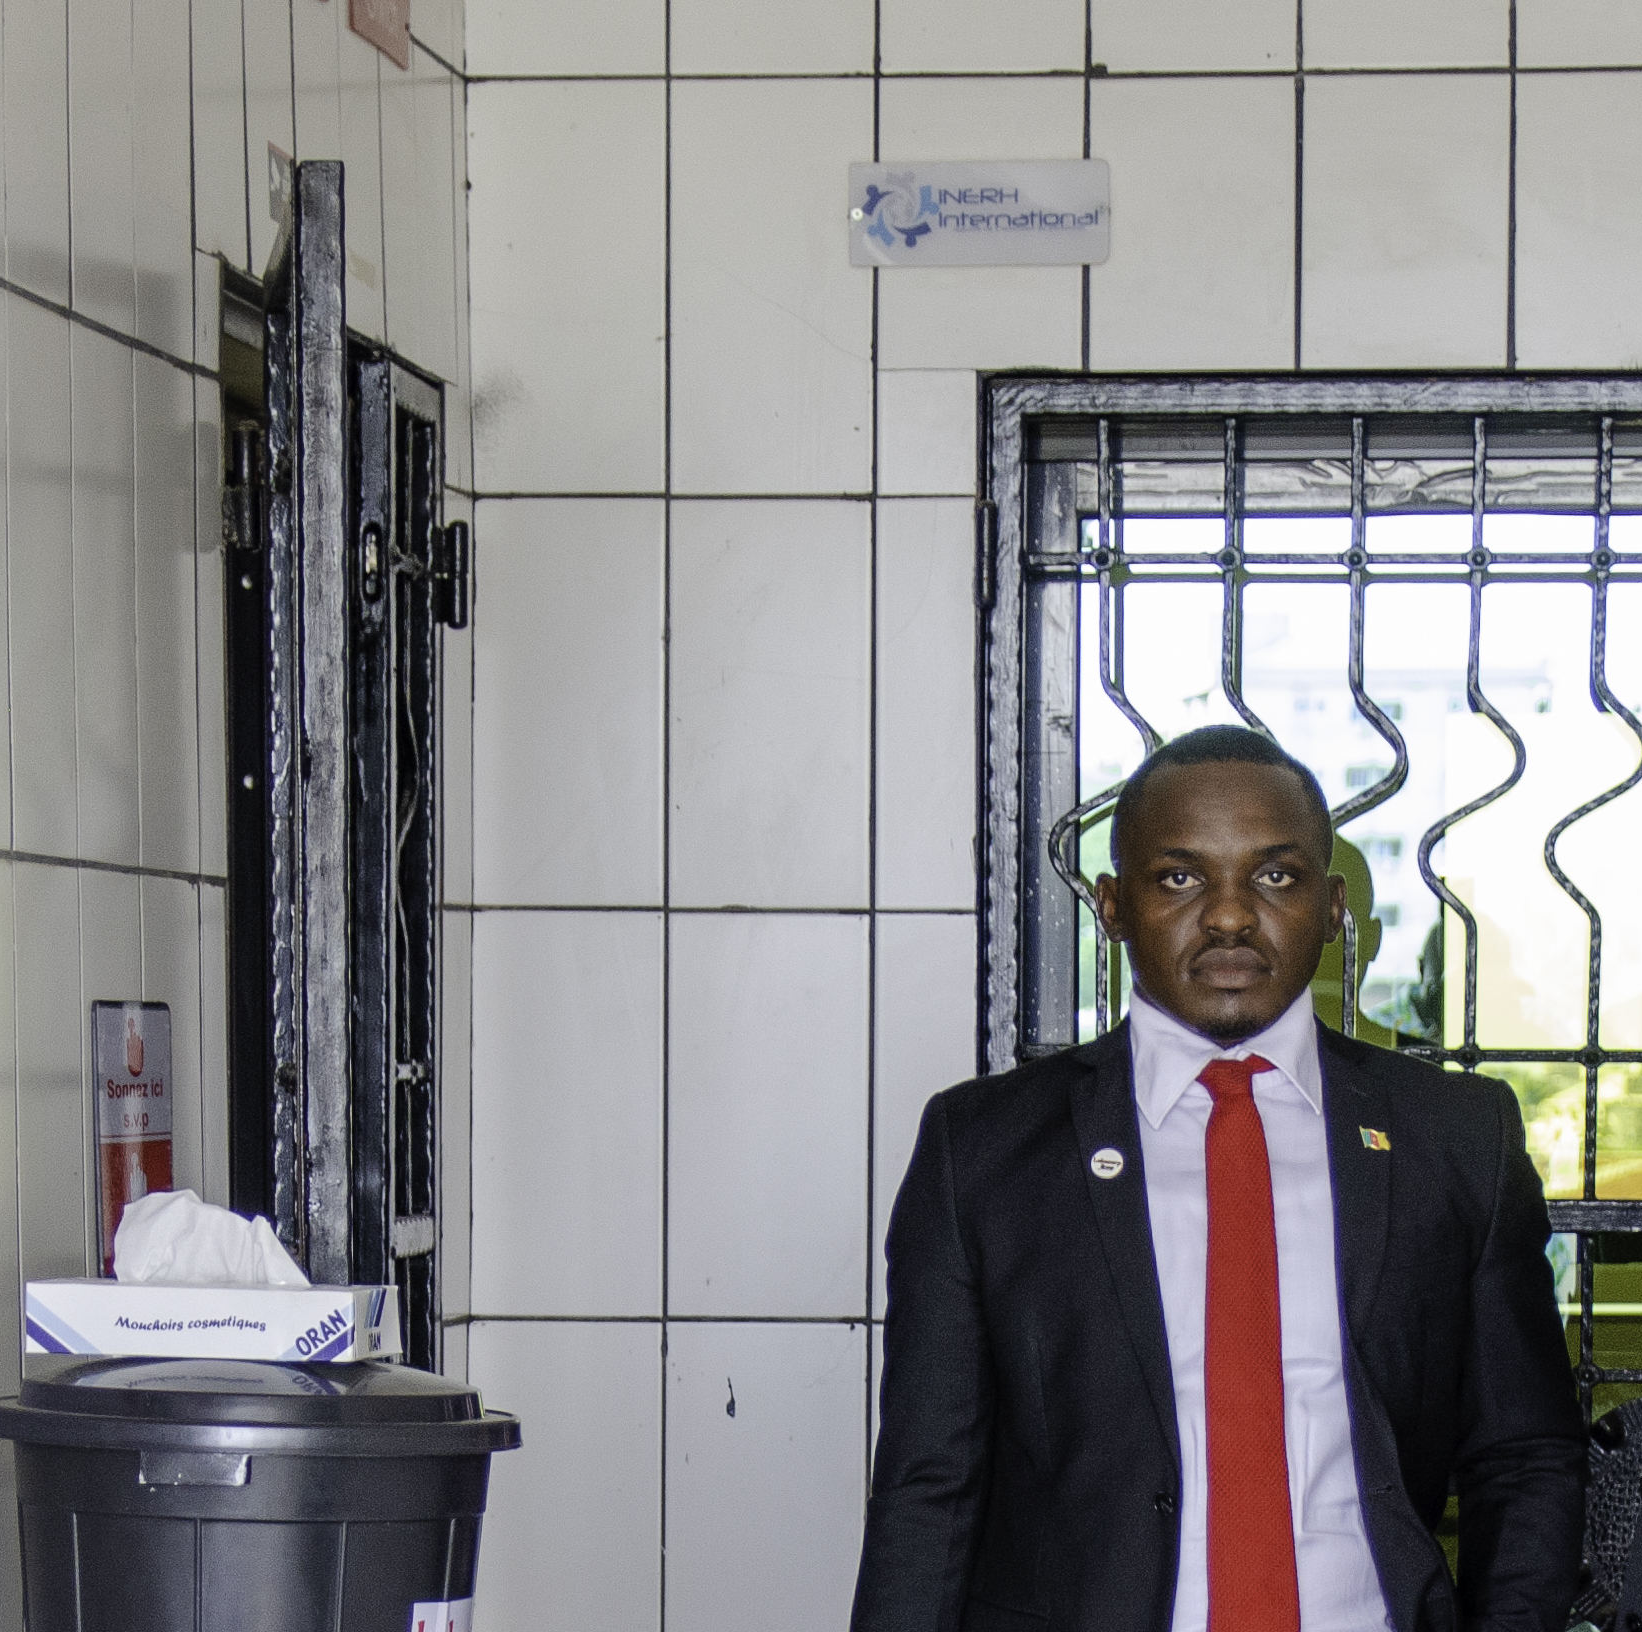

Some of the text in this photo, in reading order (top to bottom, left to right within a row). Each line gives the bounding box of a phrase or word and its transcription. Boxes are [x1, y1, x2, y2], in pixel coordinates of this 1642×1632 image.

[938, 188, 1019, 204] INERH
[938, 209, 1099, 228] International
[107, 1078, 163, 1098] Sonnez ici
[114, 1315, 267, 1332] Mouchoirs cosmetiques
[294, 1308, 348, 1356] ORAN
